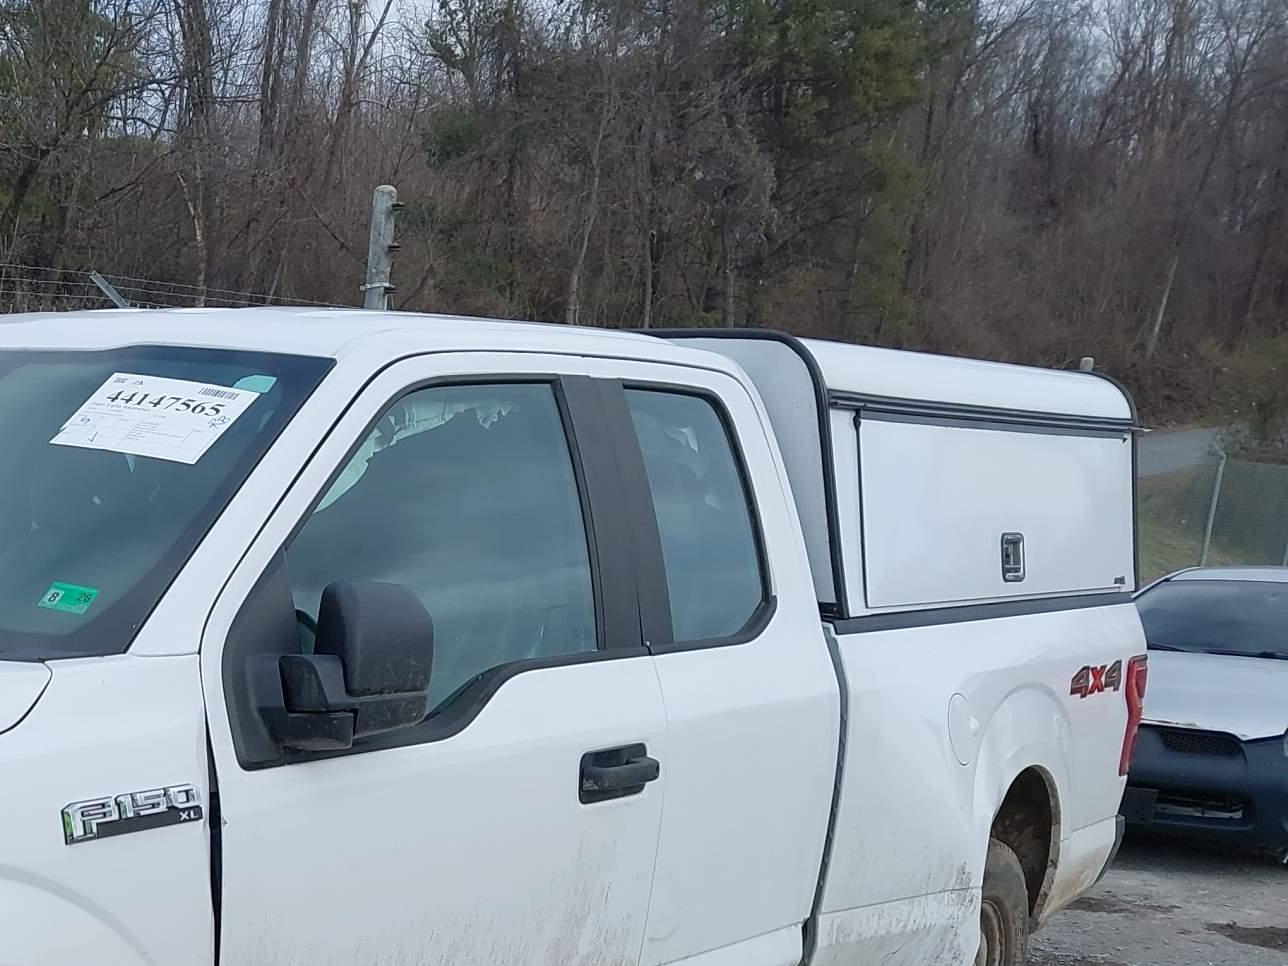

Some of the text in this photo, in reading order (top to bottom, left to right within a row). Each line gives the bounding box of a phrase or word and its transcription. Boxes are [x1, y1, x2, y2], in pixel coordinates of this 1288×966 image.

[106, 390, 226, 417] 44147565
[48, 592, 60, 603] 8
[61, 783, 202, 844] F150
[179, 810, 199, 822] XL
